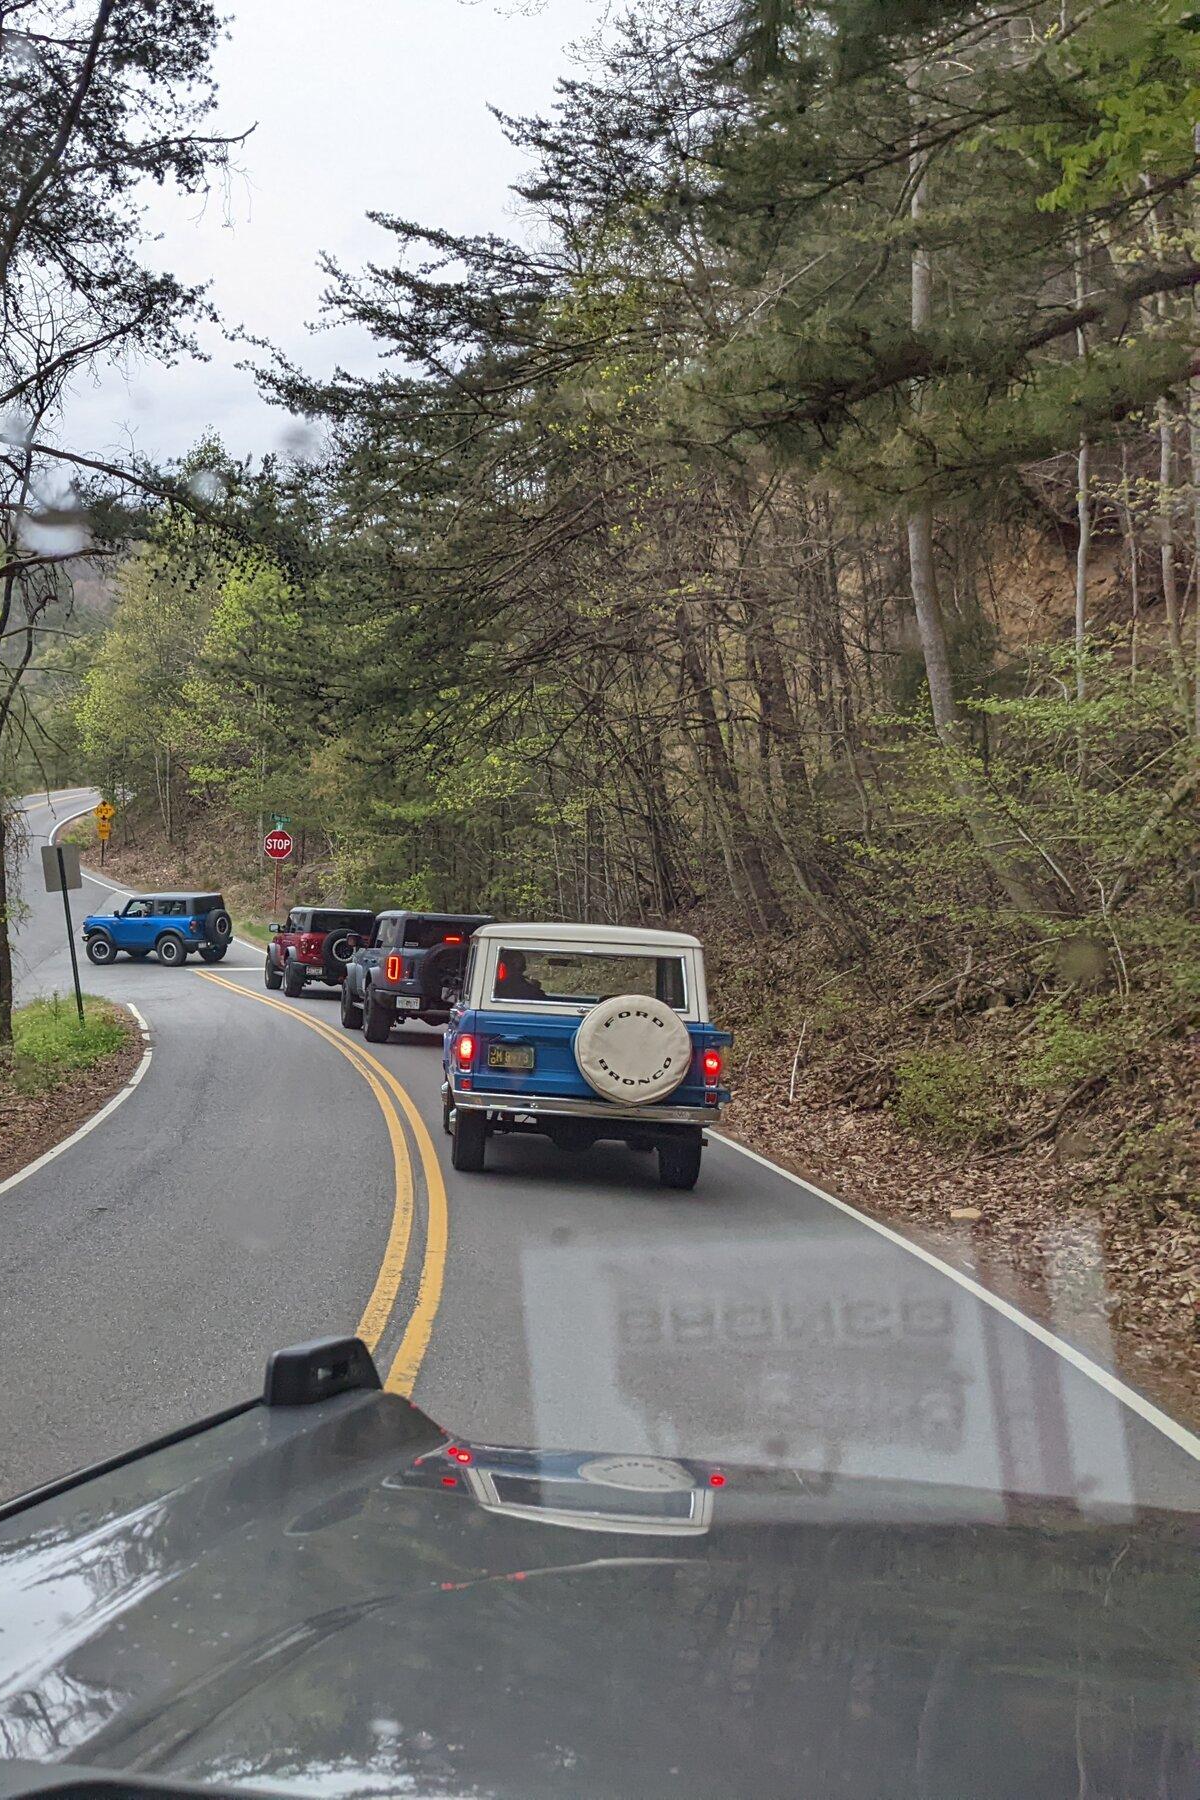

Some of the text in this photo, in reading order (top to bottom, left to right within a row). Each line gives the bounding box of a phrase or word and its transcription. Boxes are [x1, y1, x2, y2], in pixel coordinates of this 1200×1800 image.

[266, 838, 291, 850] STOP
[603, 1011, 664, 1028] FORD
[598, 1057, 672, 1086] BRONCO
